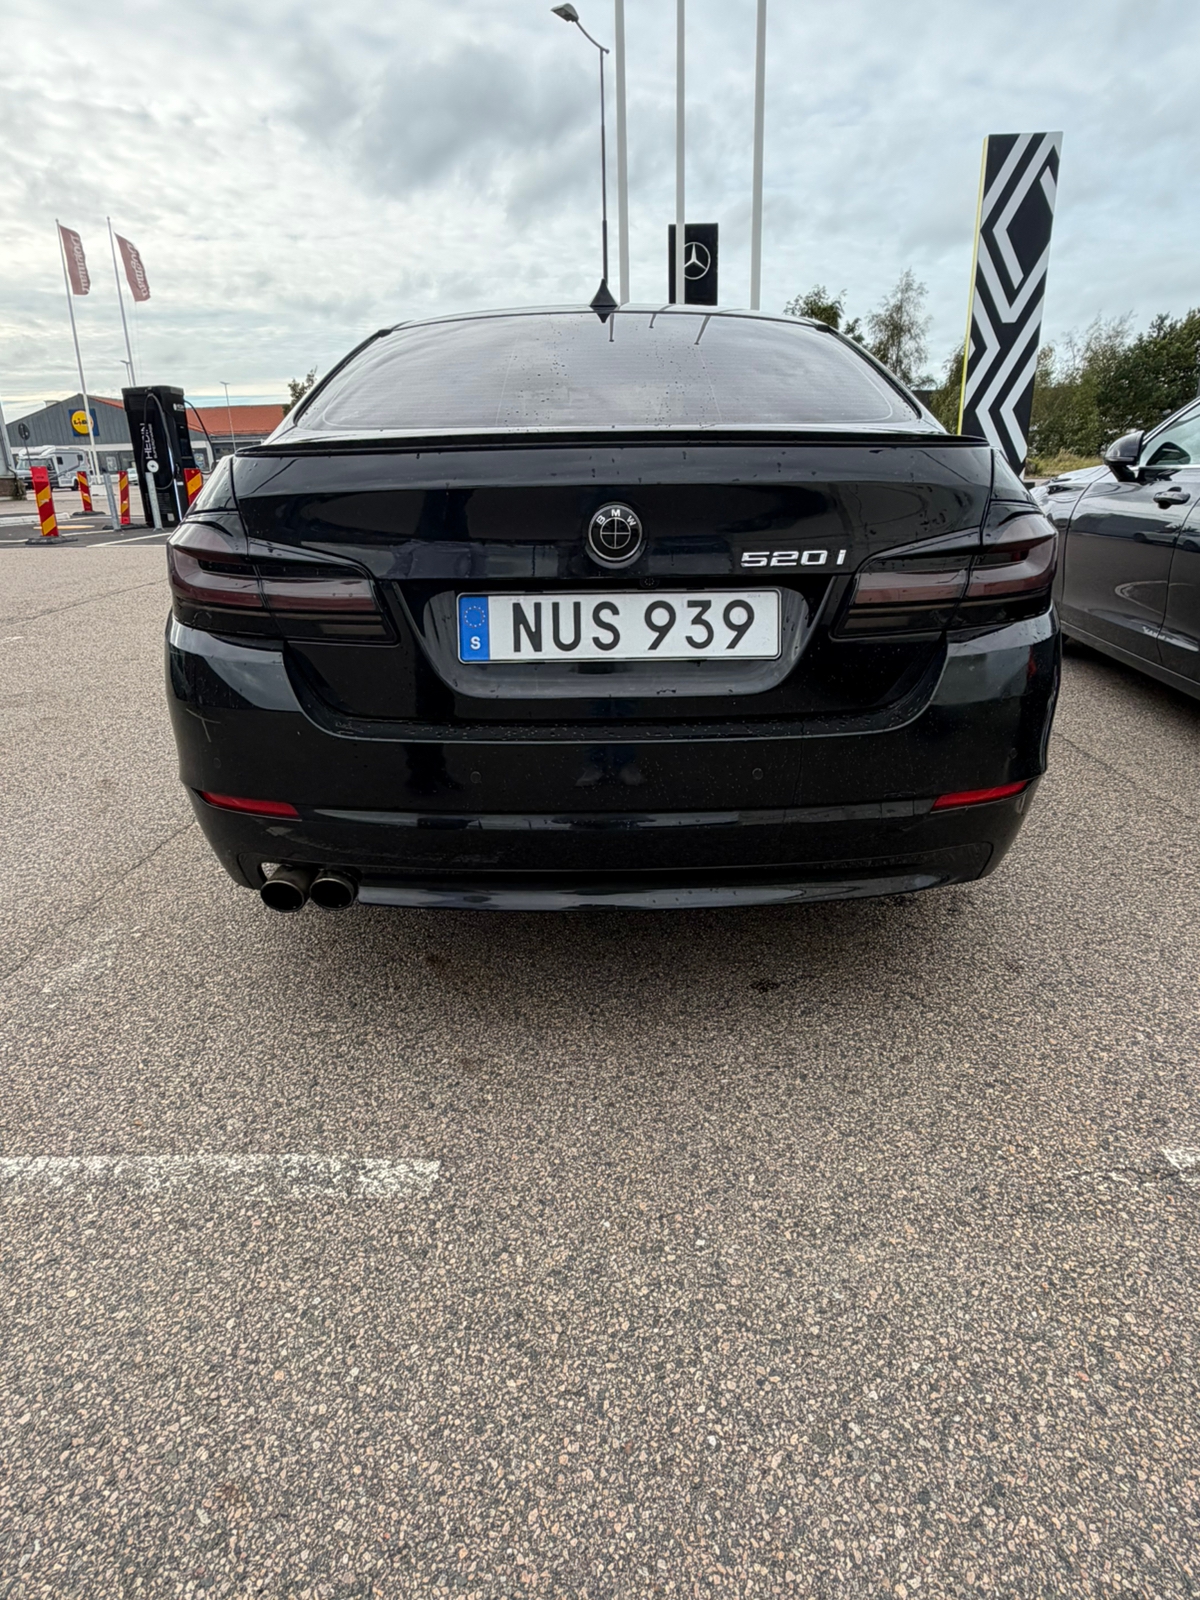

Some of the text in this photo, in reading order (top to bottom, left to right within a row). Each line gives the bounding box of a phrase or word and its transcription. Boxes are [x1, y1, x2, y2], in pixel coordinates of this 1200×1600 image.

[596, 508, 637, 526] BMW
[512, 599, 755, 653] NUS 939
[470, 635, 481, 650] S
